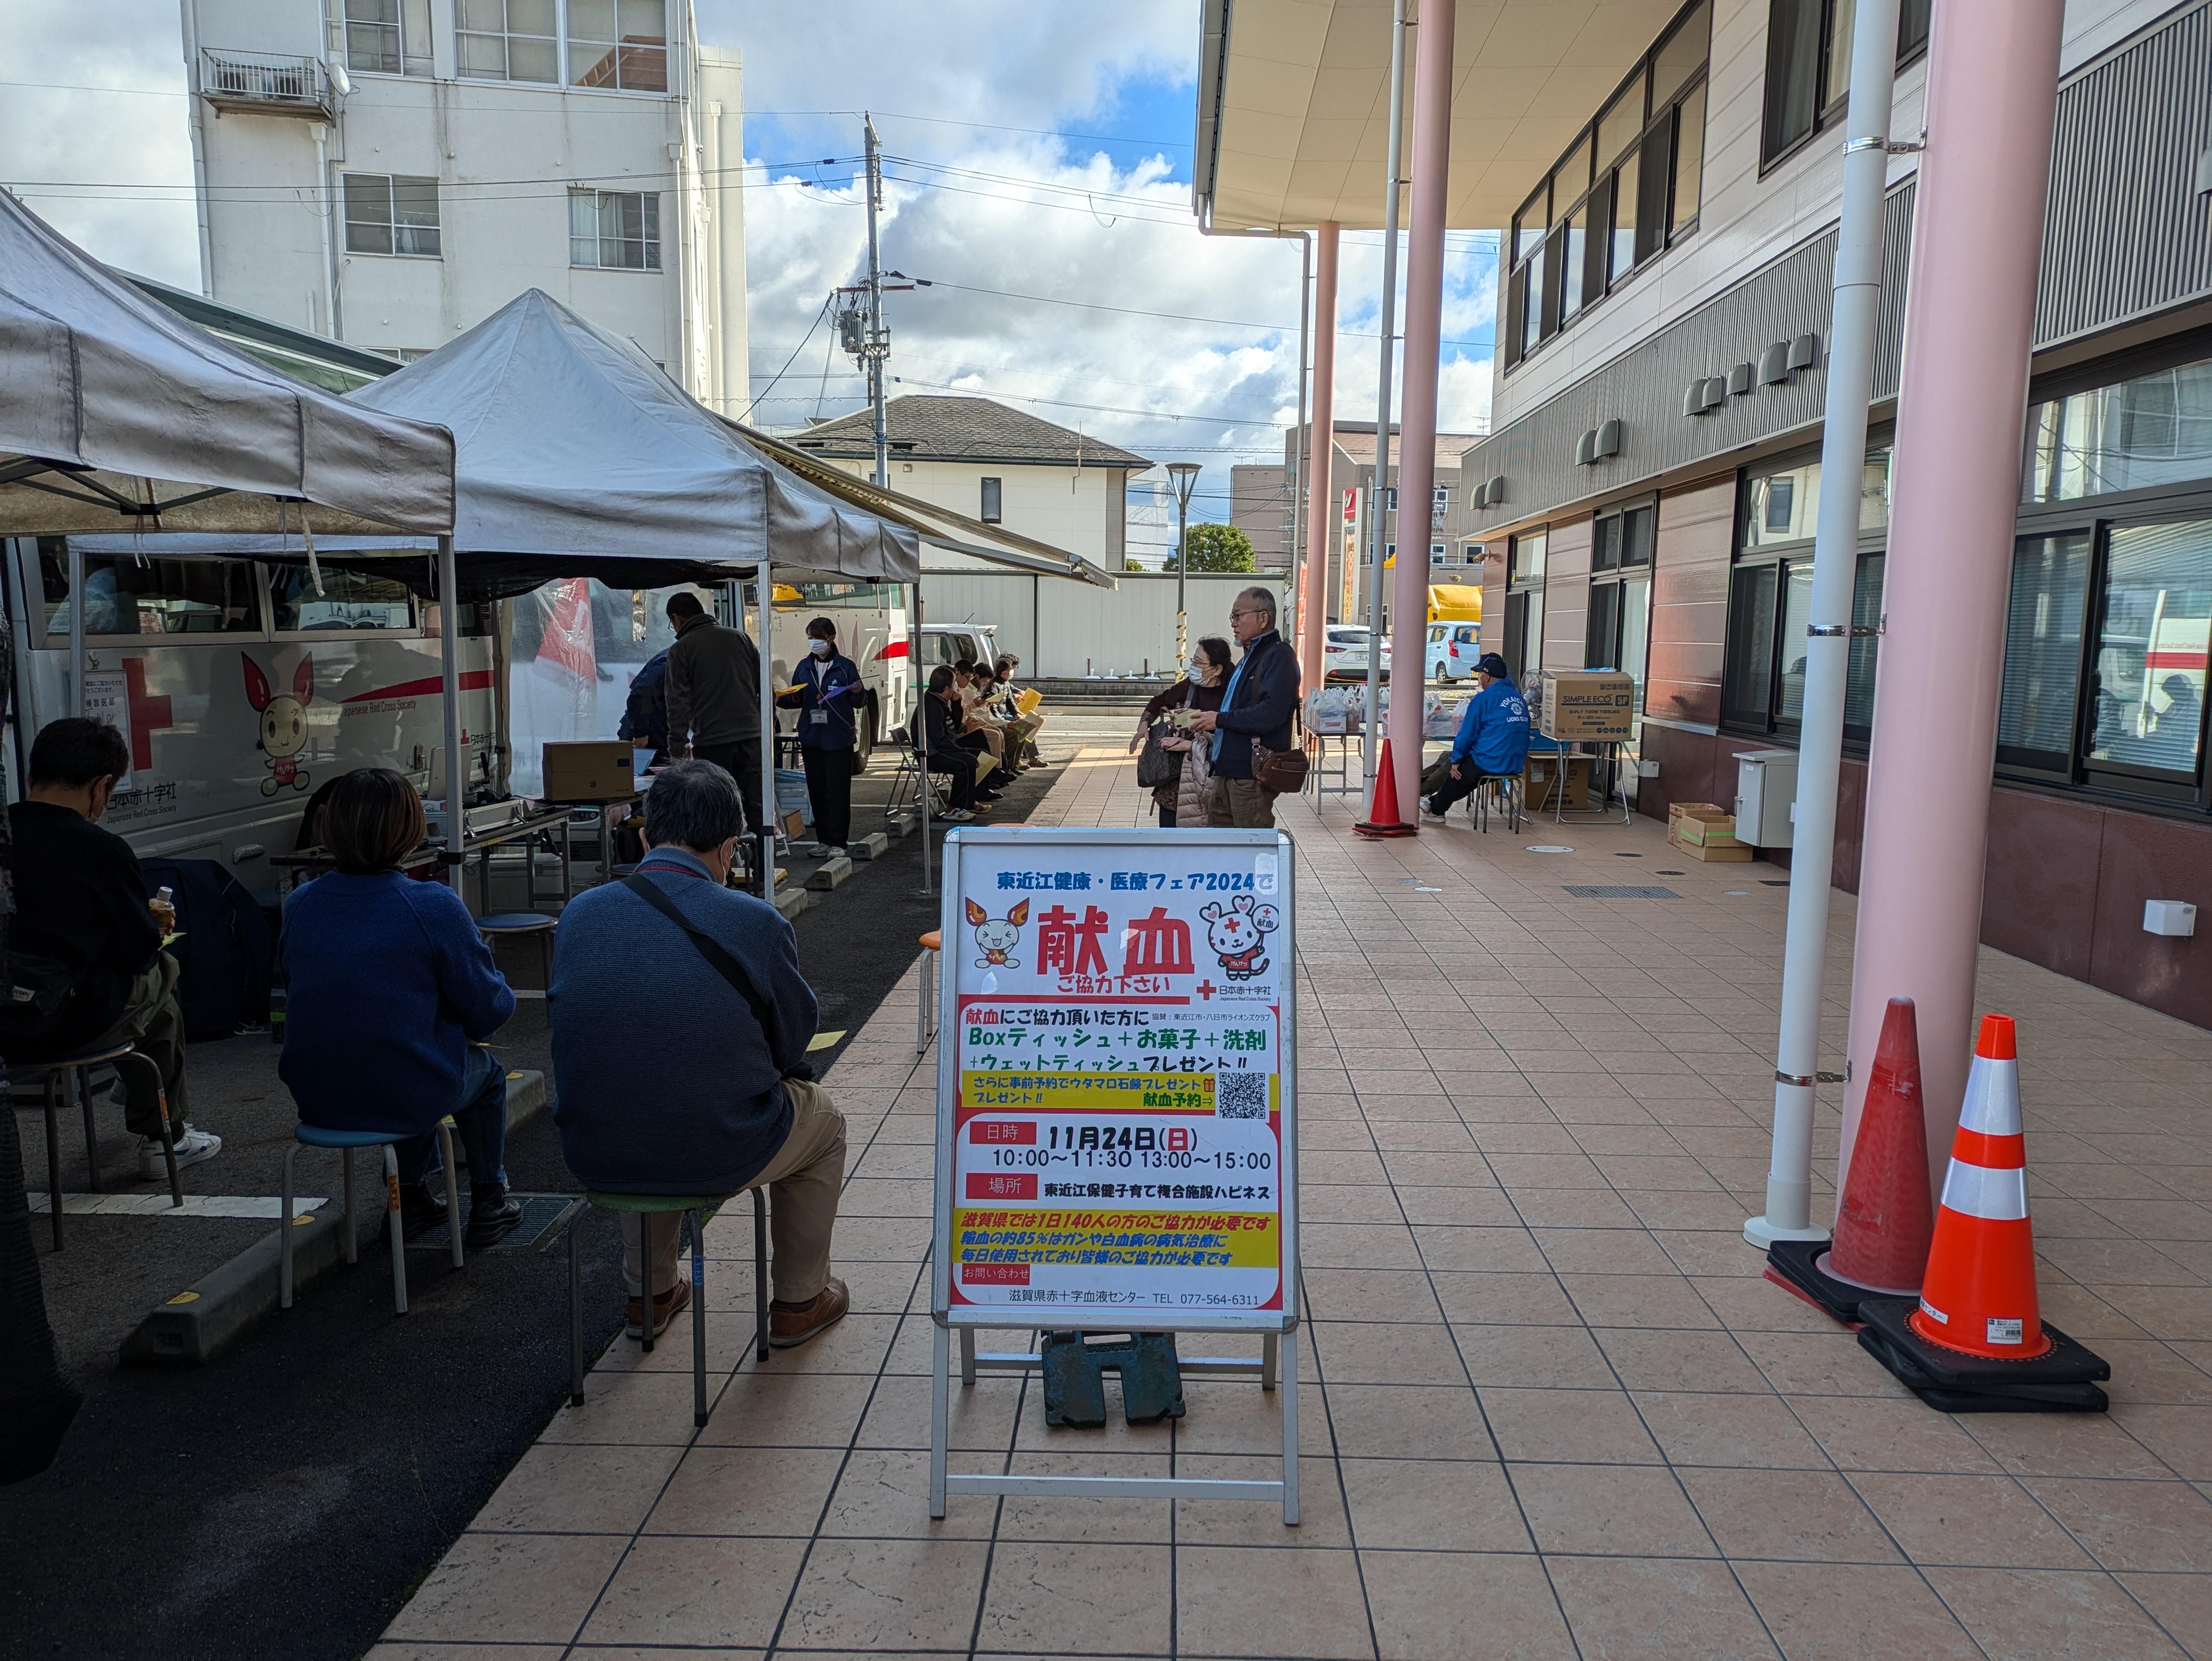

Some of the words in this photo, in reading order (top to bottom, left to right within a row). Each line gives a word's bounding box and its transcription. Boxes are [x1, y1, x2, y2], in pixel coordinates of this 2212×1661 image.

[369, 702, 380, 713] Red
[381, 700, 396, 712] Cross
[1617, 696, 1628, 705] 5P
[107, 814, 132, 824] Japanese
[133, 809, 144, 819] Red
[144, 808, 158, 817] Cross
[159, 804, 177, 814] Society
[997, 872, 1274, 891] 東近江健康・医療フェア2024で
[1257, 918, 1274, 929] 献血
[1037, 905, 1195, 976] 献血
[1057, 975, 1170, 994] ご協力下さい
[1219, 985, 1272, 995] 日本赤十字社
[965, 1008, 1149, 1026] 献血にご協力頂いた方に
[973, 1076, 1201, 1091] さらに事前予約でウタマロ石鹸プレゼント
[1143, 1092, 1202, 1107] 献血予約
[987, 1124, 1018, 1141] 日時
[1050, 1126, 1197, 1151] 11月24日(日)
[988, 1177, 1022, 1195] 場所
[1044, 1182, 1271, 1200] 東近江保健子育て複合施設ハピネス
[961, 1211, 1271, 1231] 滋賀県では1日140人の方のご協力が必要です
[960, 1248, 1233, 1266] 毎日使用されており皆様のご協力が必要です
[964, 1267, 1030, 1279] お問い合わせ
[1009, 1289, 1145, 1303] 滋賀県赤十字血液センター
[1152, 1293, 1173, 1304] TEL
[1180, 1294, 1259, 1306] 077-564-6311
